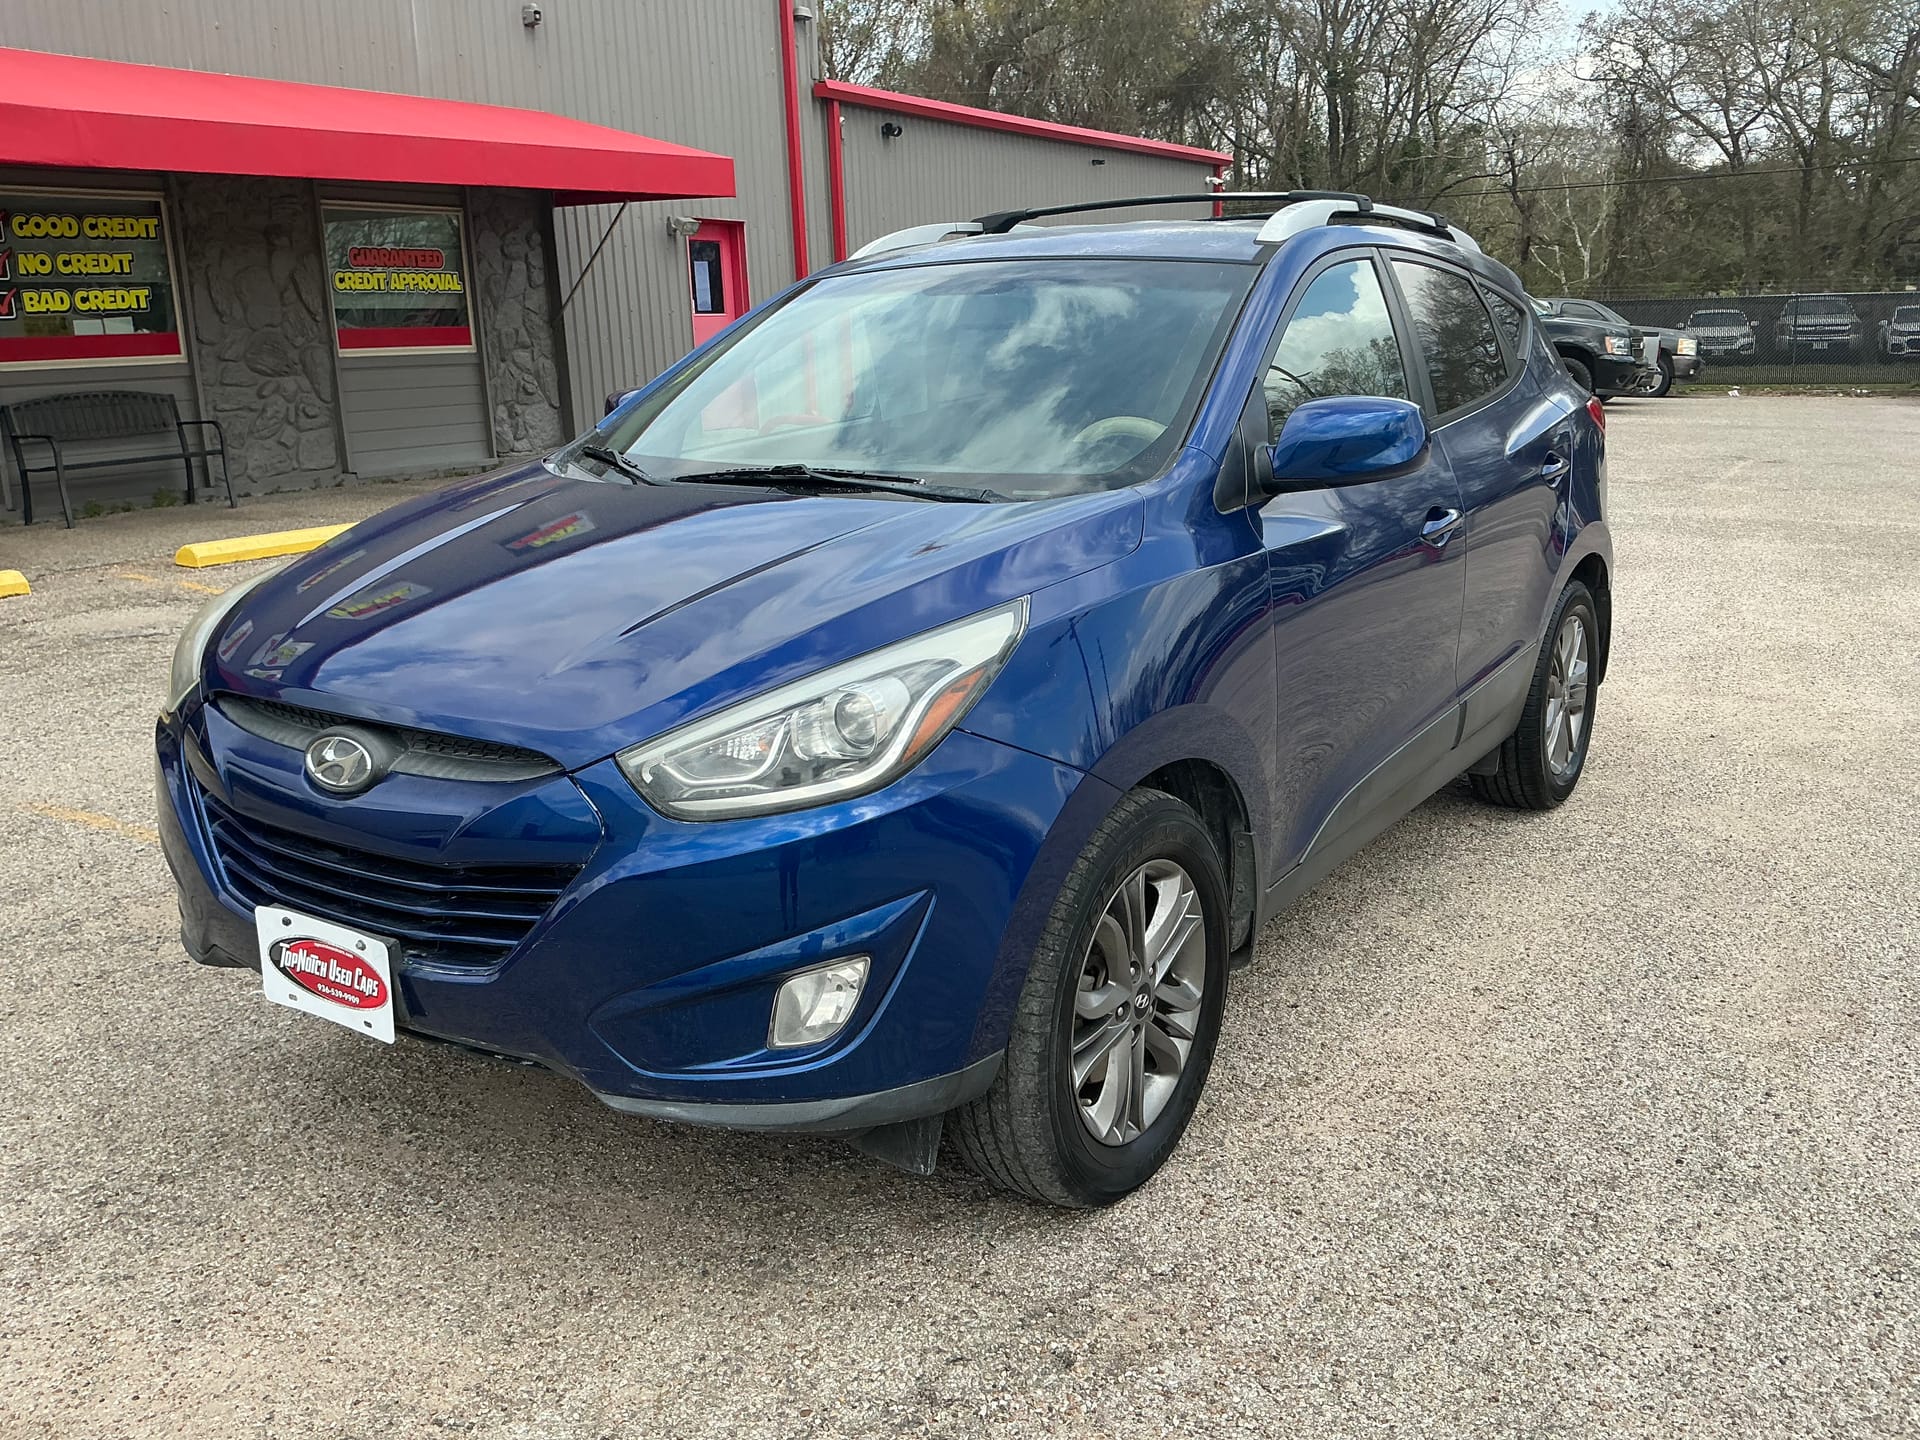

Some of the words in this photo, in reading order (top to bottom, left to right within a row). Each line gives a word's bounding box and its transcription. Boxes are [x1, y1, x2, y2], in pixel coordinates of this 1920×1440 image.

[11, 215, 80, 238] GOOD
[82, 216, 159, 239] CREDIT
[17, 252, 53, 275] NO
[56, 252, 133, 275] CREDIT
[349, 247, 444, 269] GUARANTEED
[334, 271, 388, 291] CREDIT
[389, 272, 462, 291] APPROVAL
[22, 290, 71, 313] BAD
[74, 288, 150, 312] CREDIT
